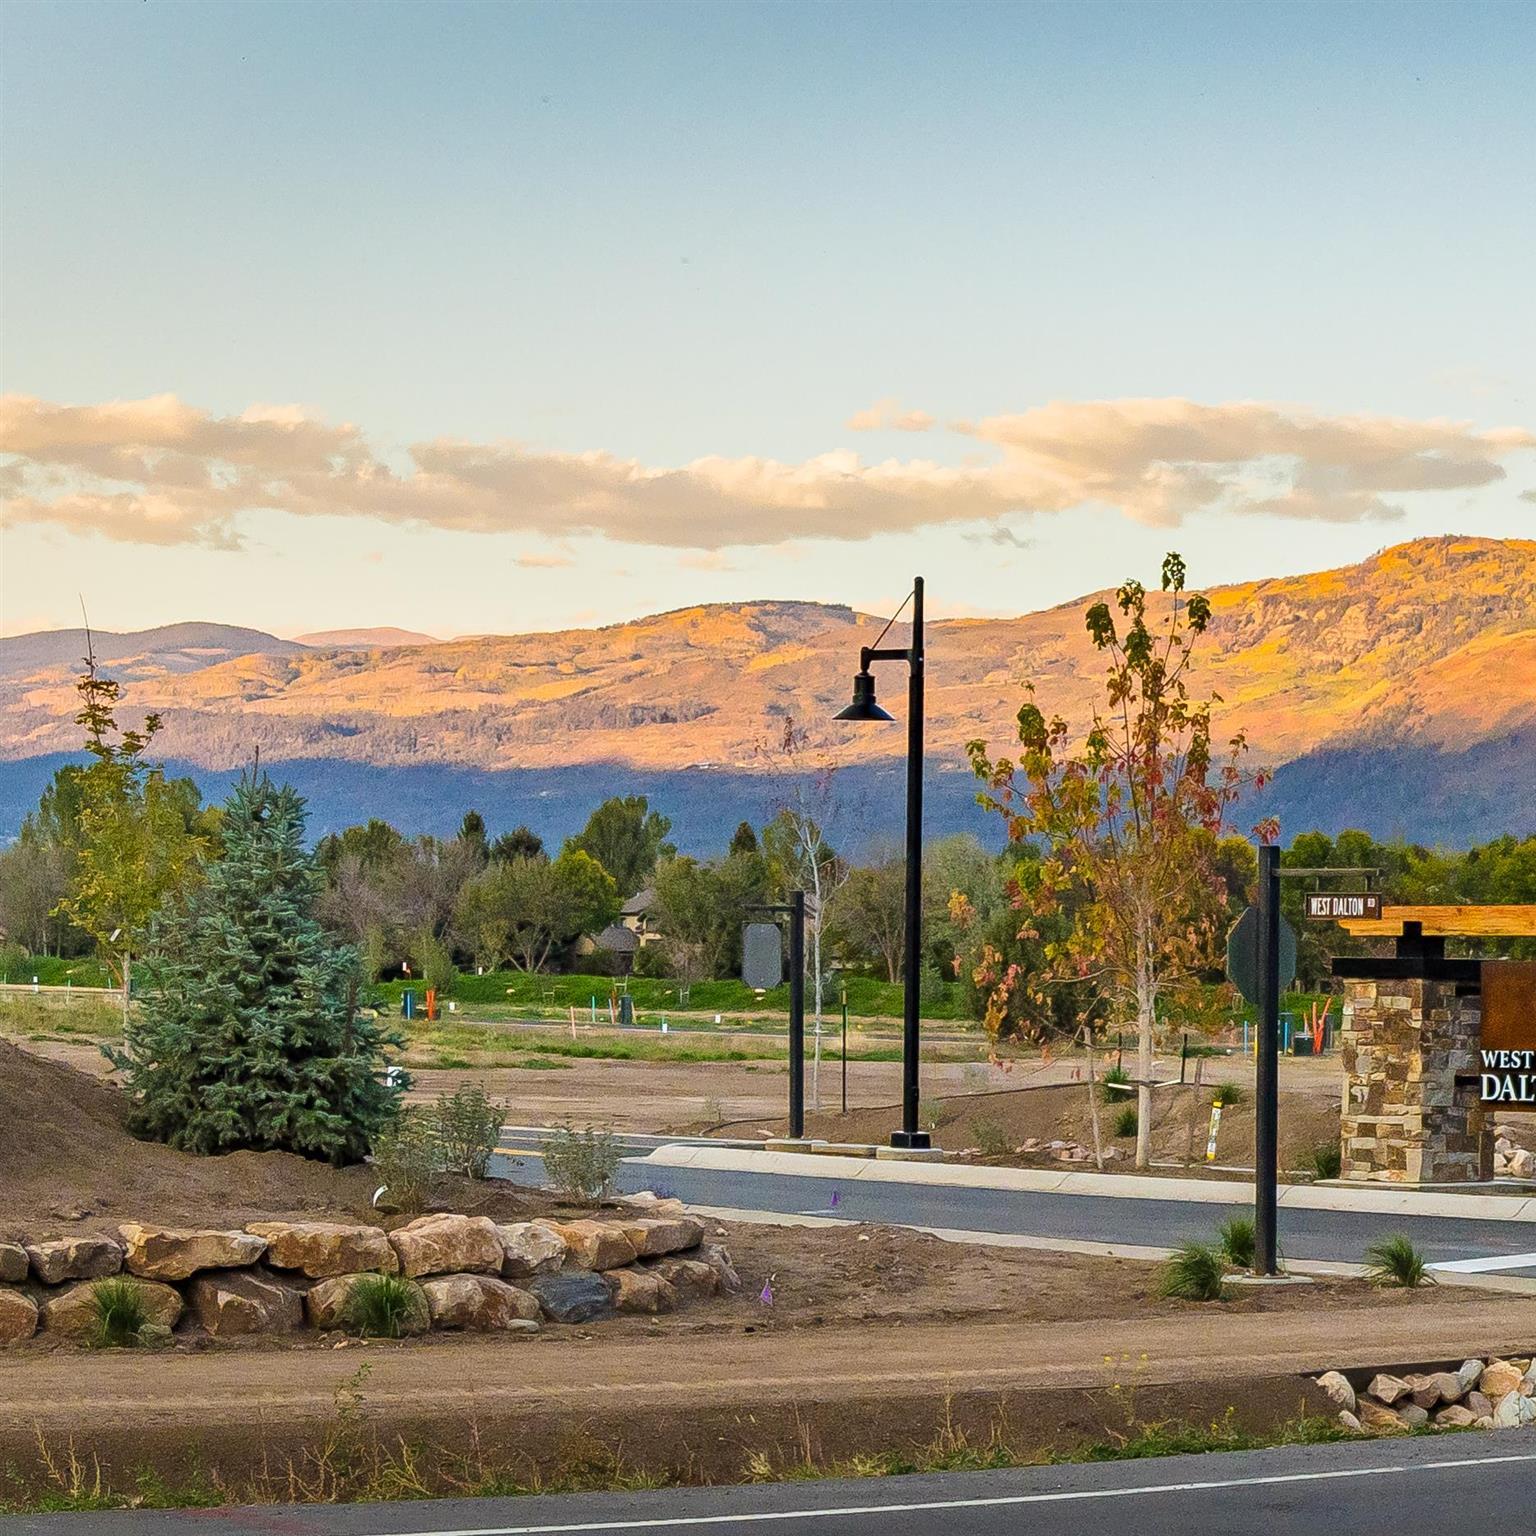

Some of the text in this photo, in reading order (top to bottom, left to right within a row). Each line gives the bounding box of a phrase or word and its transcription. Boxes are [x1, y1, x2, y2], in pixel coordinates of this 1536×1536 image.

[1311, 897, 1331, 915] WEST
[1333, 897, 1364, 916] DALTON
[1480, 1050, 1535, 1069] WEST
